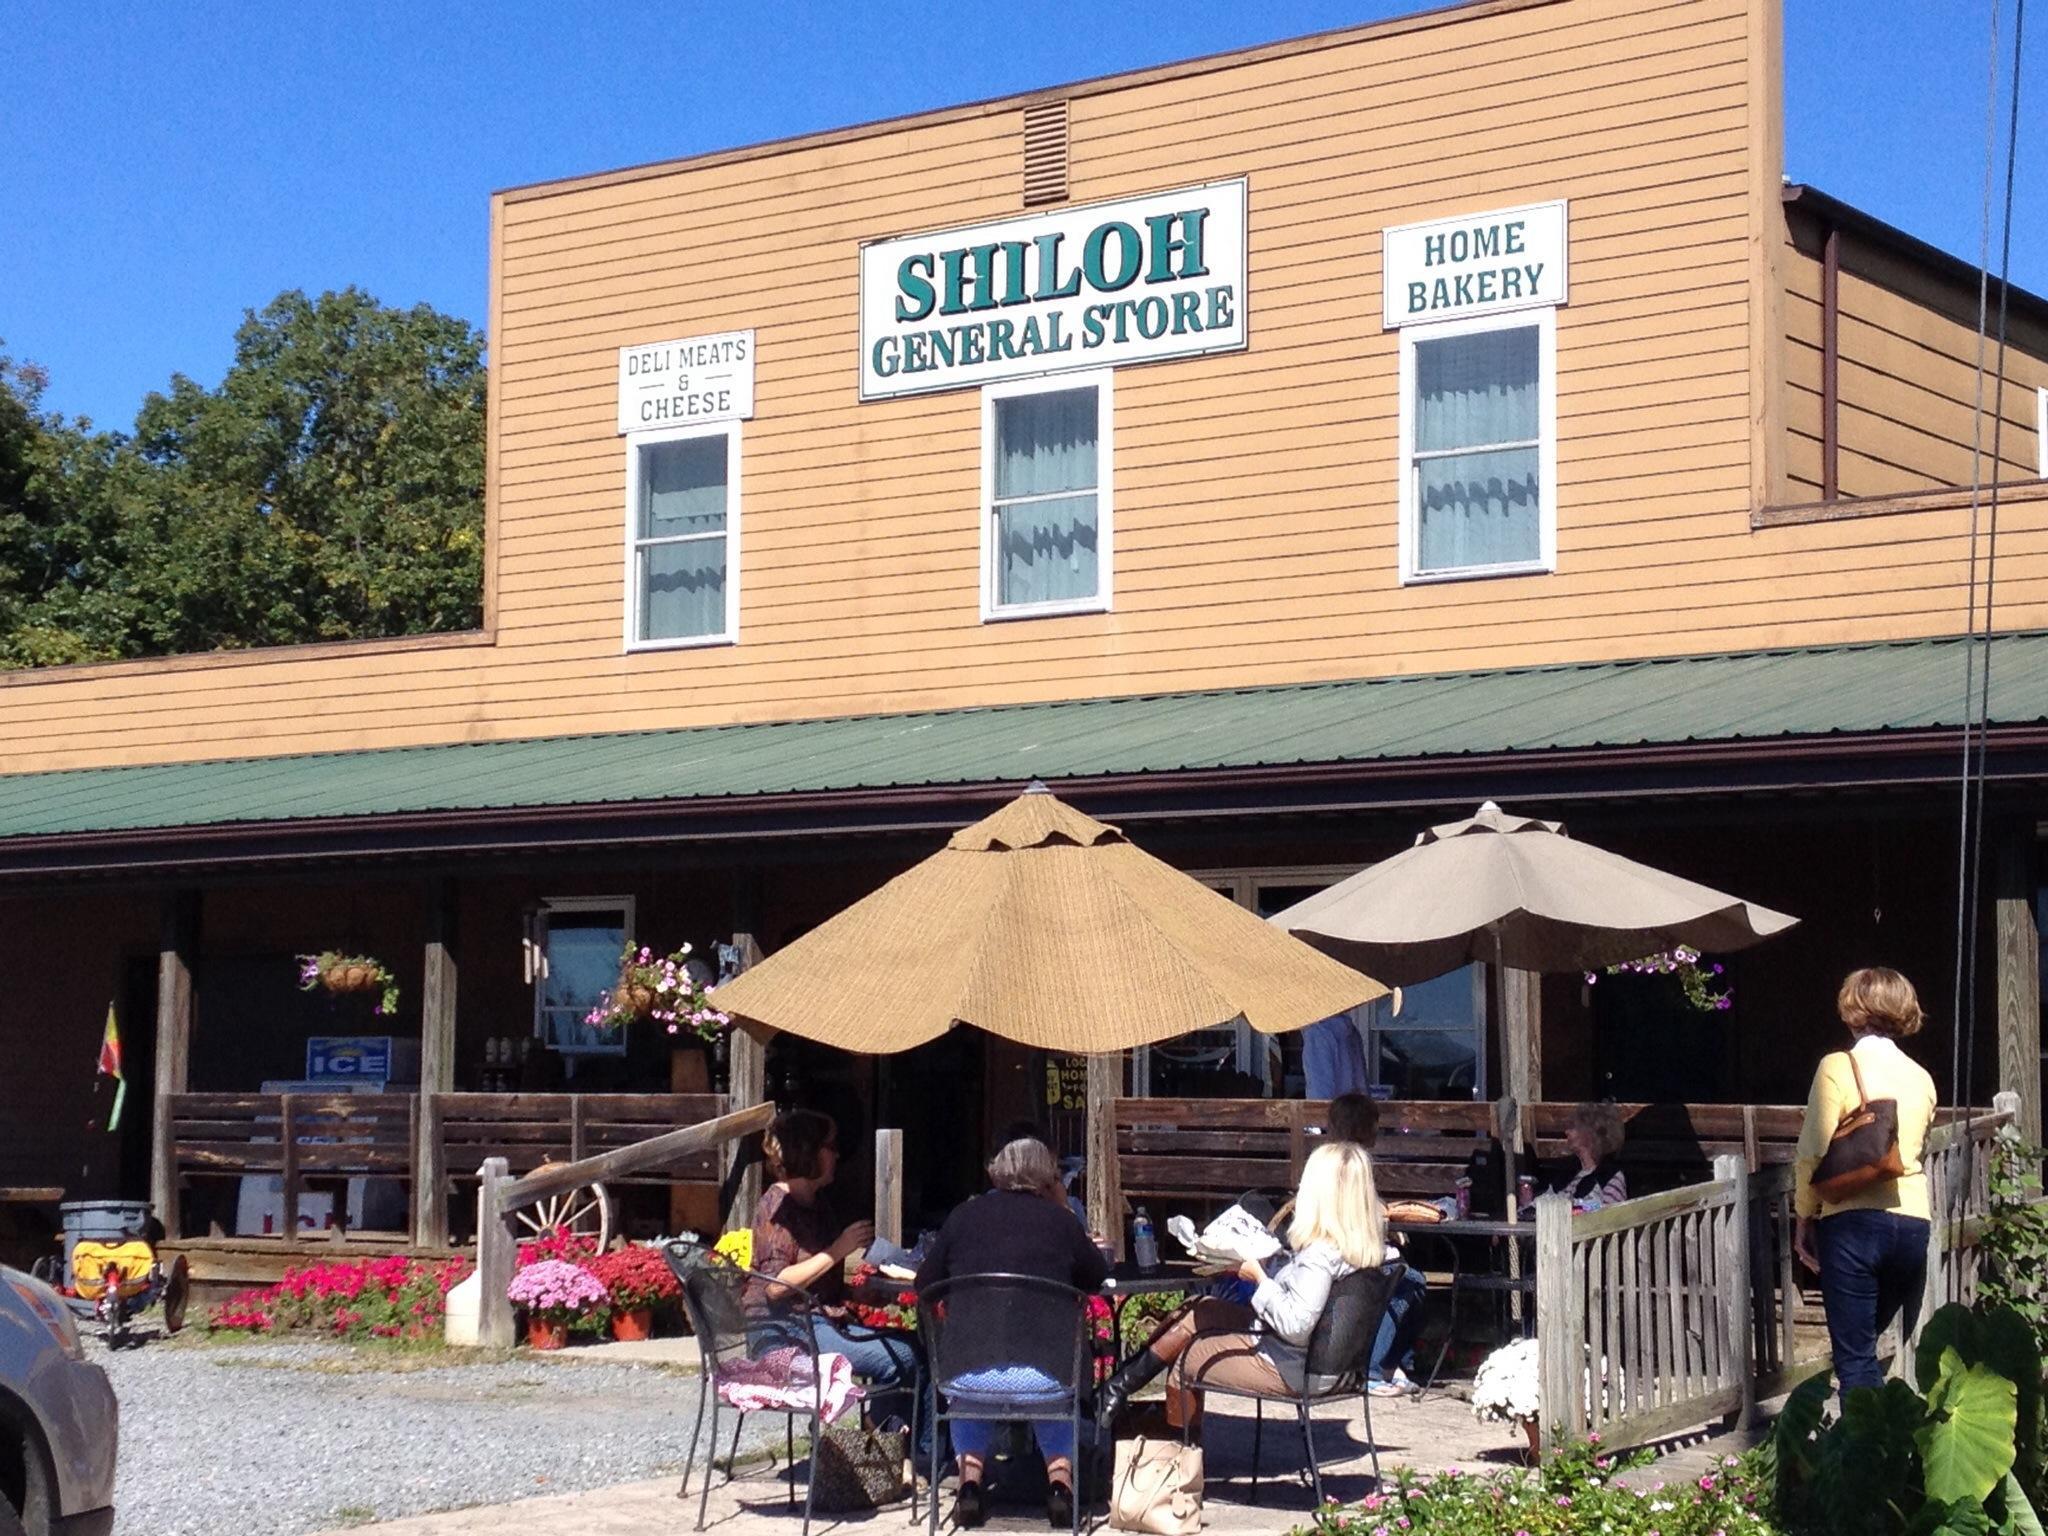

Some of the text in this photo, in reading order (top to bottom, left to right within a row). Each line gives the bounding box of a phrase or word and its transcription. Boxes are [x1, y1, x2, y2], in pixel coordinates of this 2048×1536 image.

[1424, 221, 1525, 267] HOME
[895, 208, 1210, 323] SHILOH
[1407, 263, 1544, 313] BAKERY
[872, 285, 1234, 378] GENERAL STORE
[628, 339, 746, 376] DELI MEATS
[678, 374, 689, 391] &
[641, 390, 731, 421] CHEESE
[314, 1056, 385, 1073] ICE
[1065, 1058, 1088, 1068] LOC
[1063, 1094, 1087, 1109] SA
